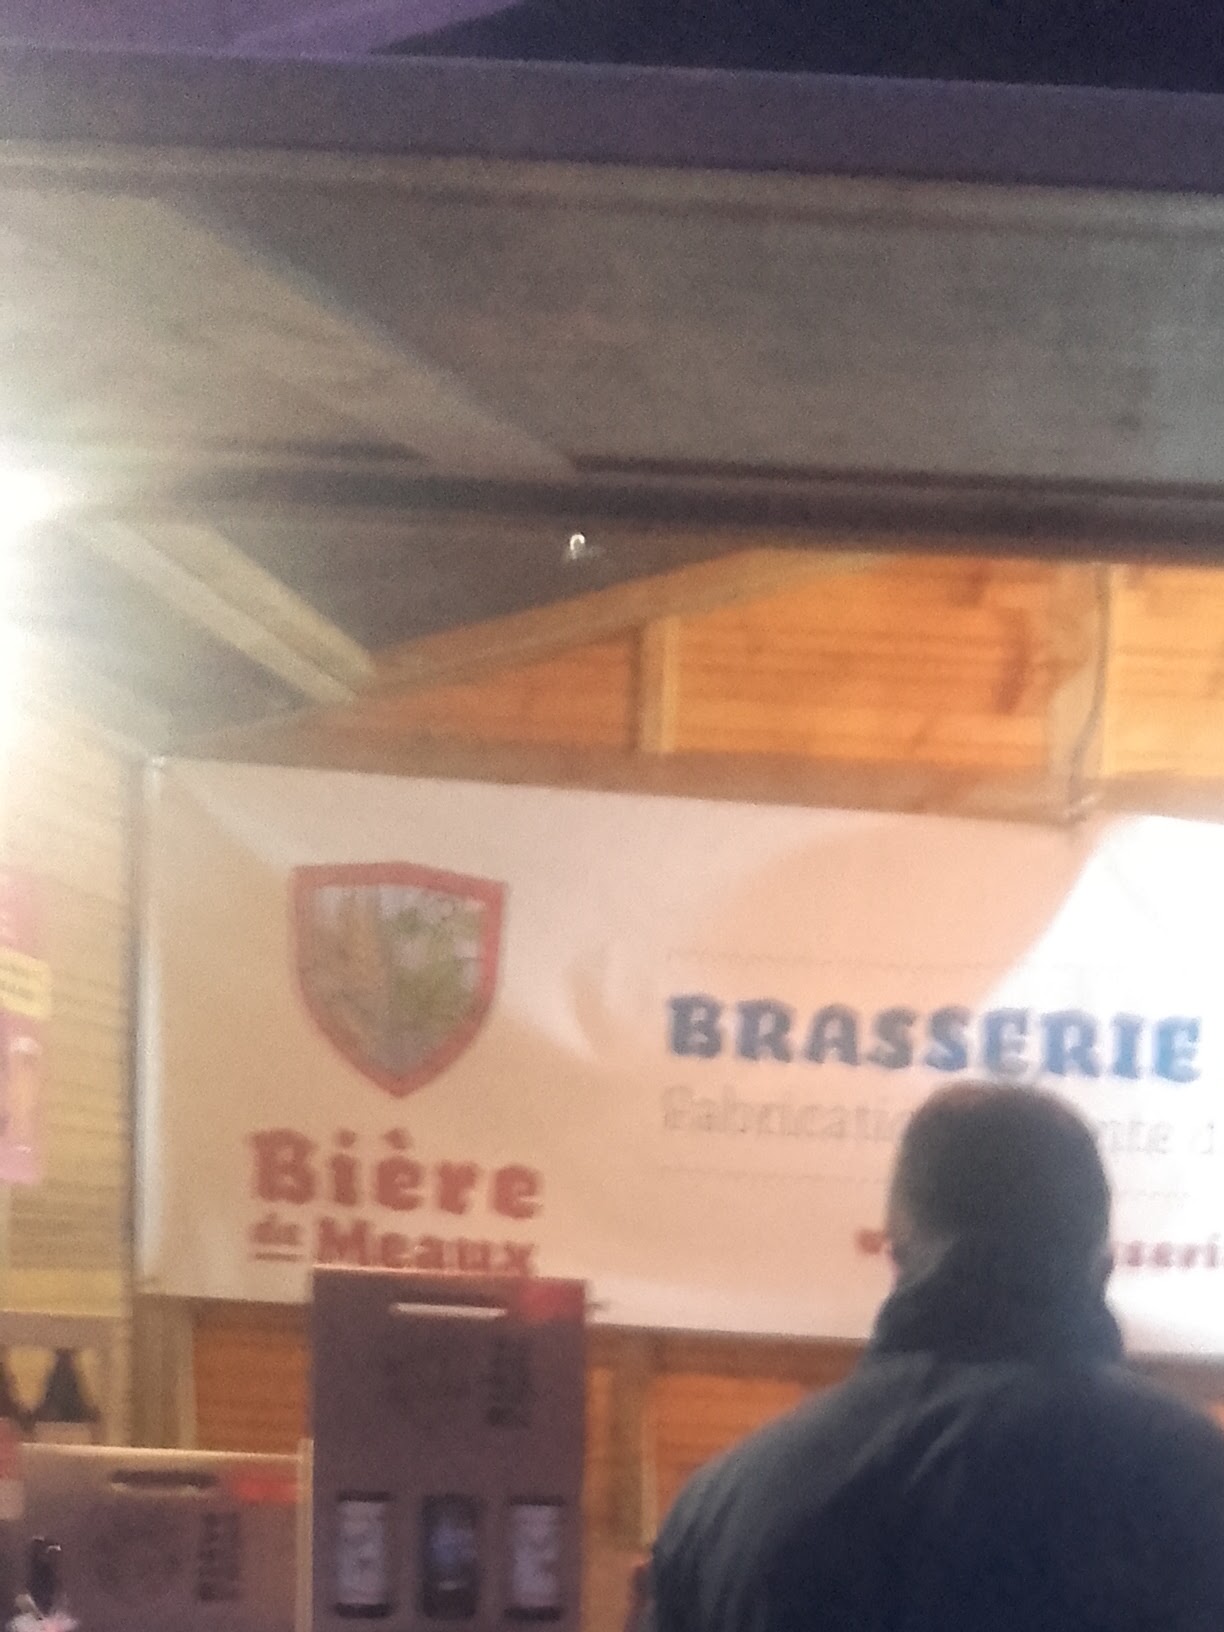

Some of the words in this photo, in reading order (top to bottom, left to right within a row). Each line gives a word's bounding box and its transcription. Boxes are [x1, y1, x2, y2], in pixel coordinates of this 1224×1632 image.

[668, 993, 1203, 1084] BRASSERIE
[246, 1126, 544, 1219] Bière
[312, 1217, 538, 1276] Meaux
